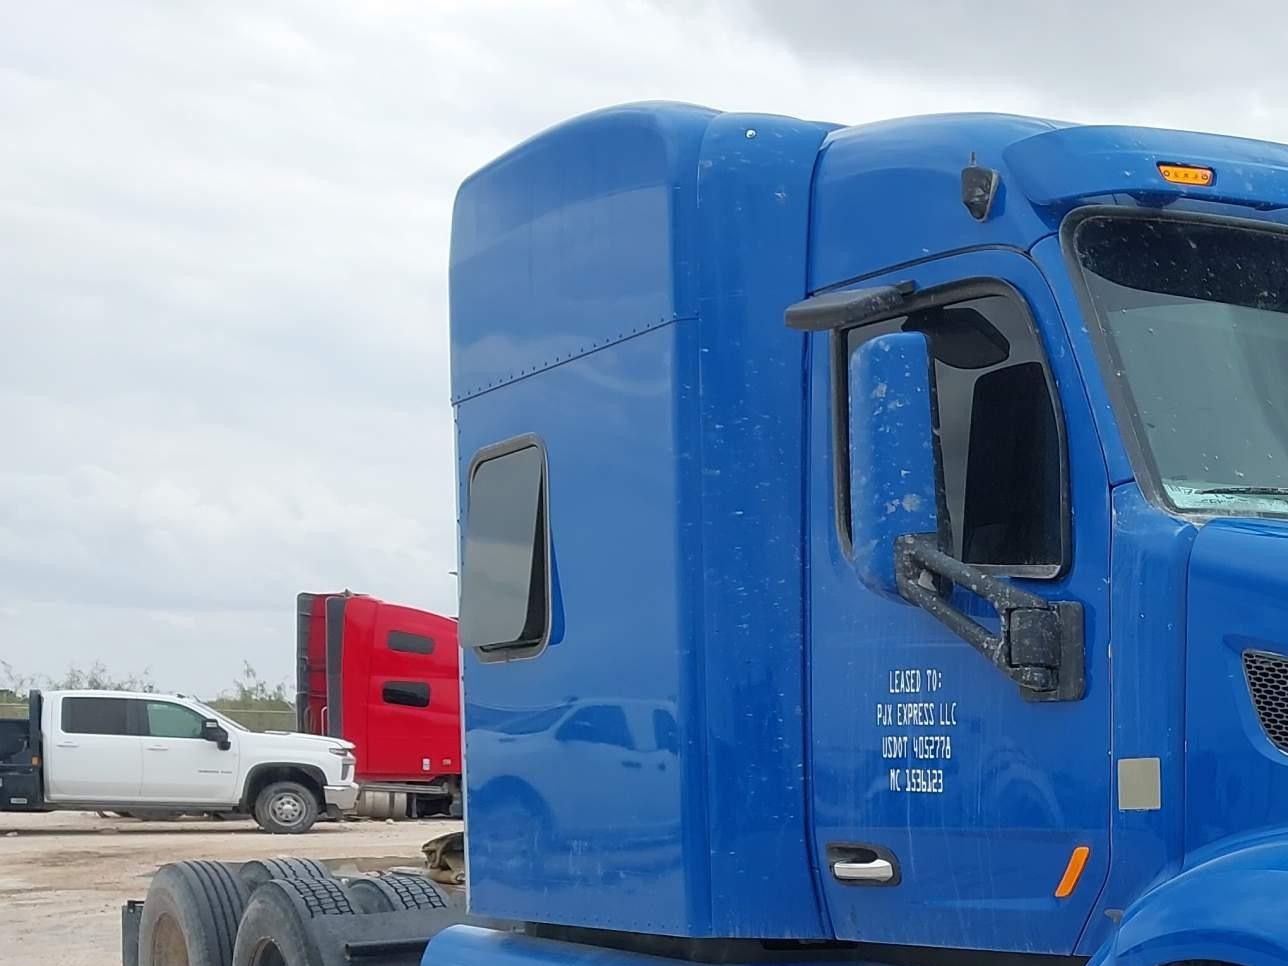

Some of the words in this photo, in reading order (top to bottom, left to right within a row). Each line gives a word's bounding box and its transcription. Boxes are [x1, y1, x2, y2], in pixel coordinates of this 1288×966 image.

[889, 669, 921, 693] LEASED
[926, 669, 942, 692] TO:
[877, 703, 893, 726] PJX
[897, 702, 935, 726] EXPRESS
[940, 702, 957, 726] LLC
[882, 736, 908, 758] USDOT
[912, 736, 951, 759] 4052778
[890, 769, 901, 791] MC
[905, 769, 943, 793] 1536123
